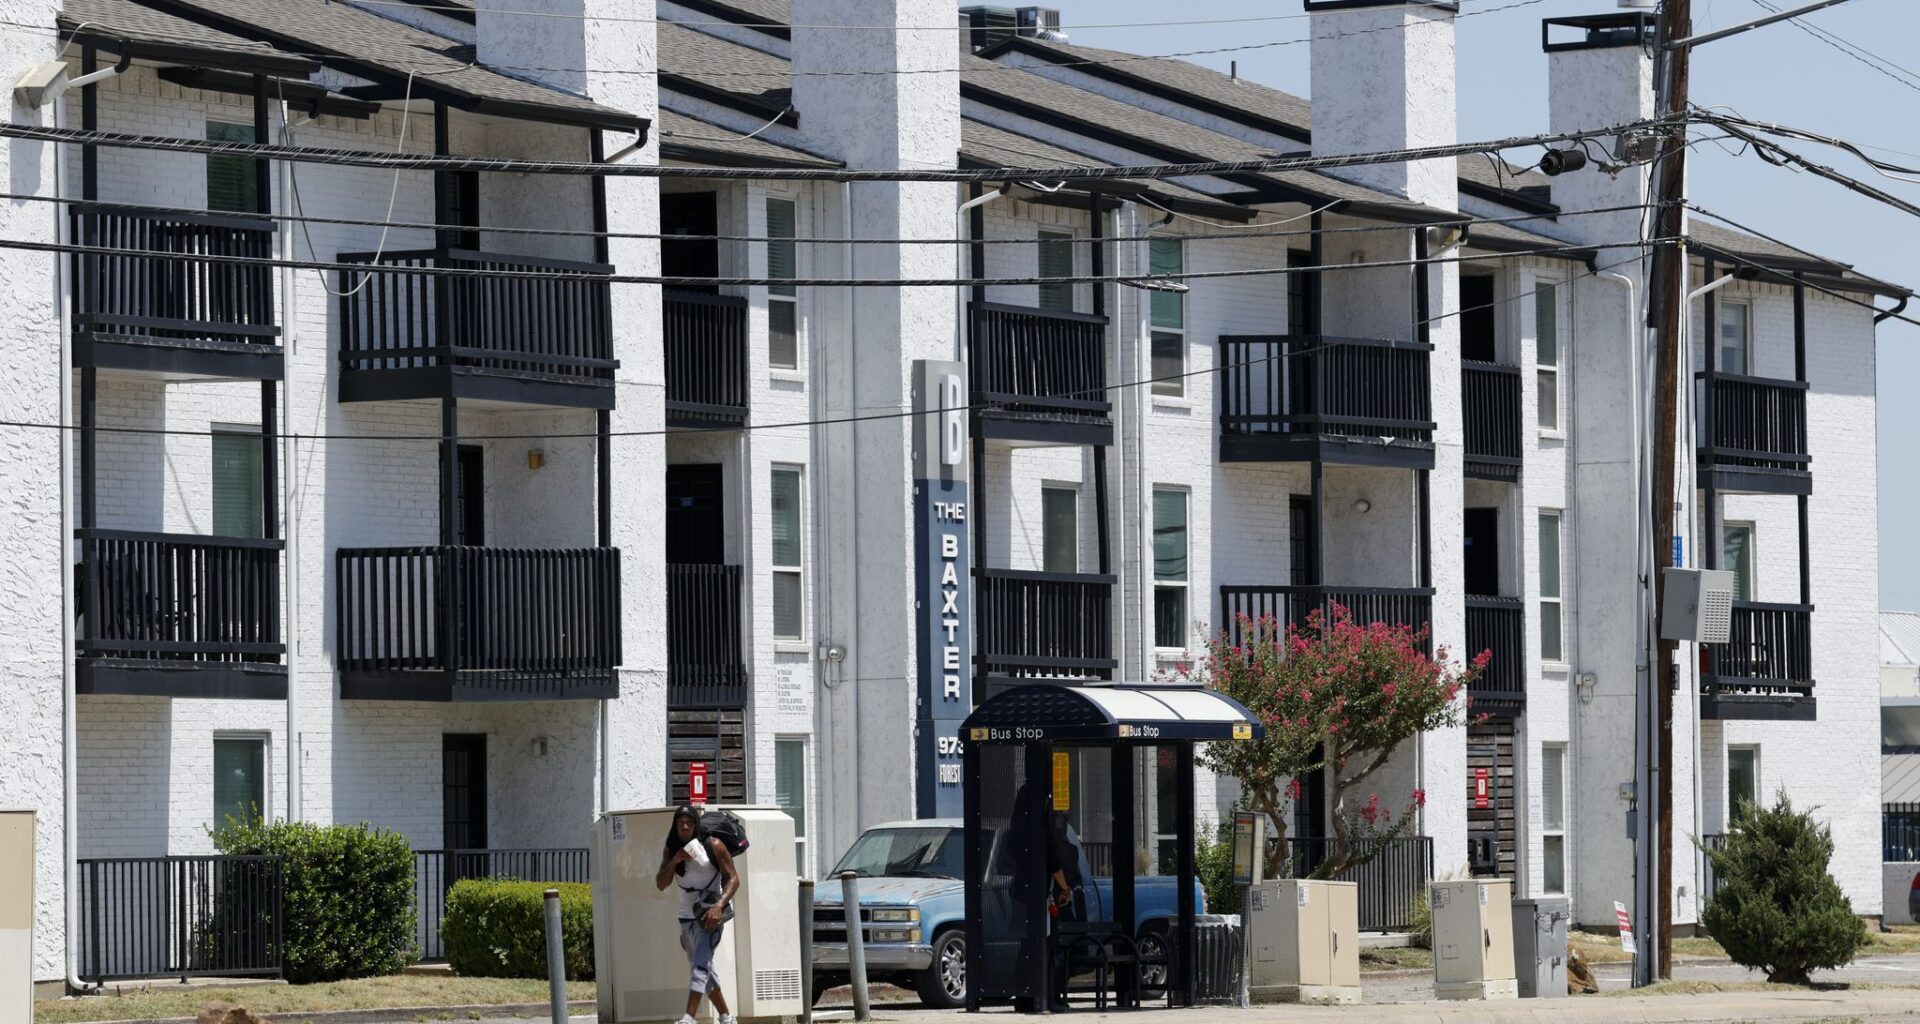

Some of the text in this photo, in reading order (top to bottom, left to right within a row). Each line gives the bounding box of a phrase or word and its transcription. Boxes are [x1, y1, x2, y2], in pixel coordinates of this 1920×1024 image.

[942, 374, 962, 464] B
[935, 502, 965, 519] THE
[942, 534, 960, 698] BAXTER
[991, 727, 1044, 740] Bus Stop
[1130, 725, 1159, 738] Bus Stop
[939, 764, 961, 783] FOREST
